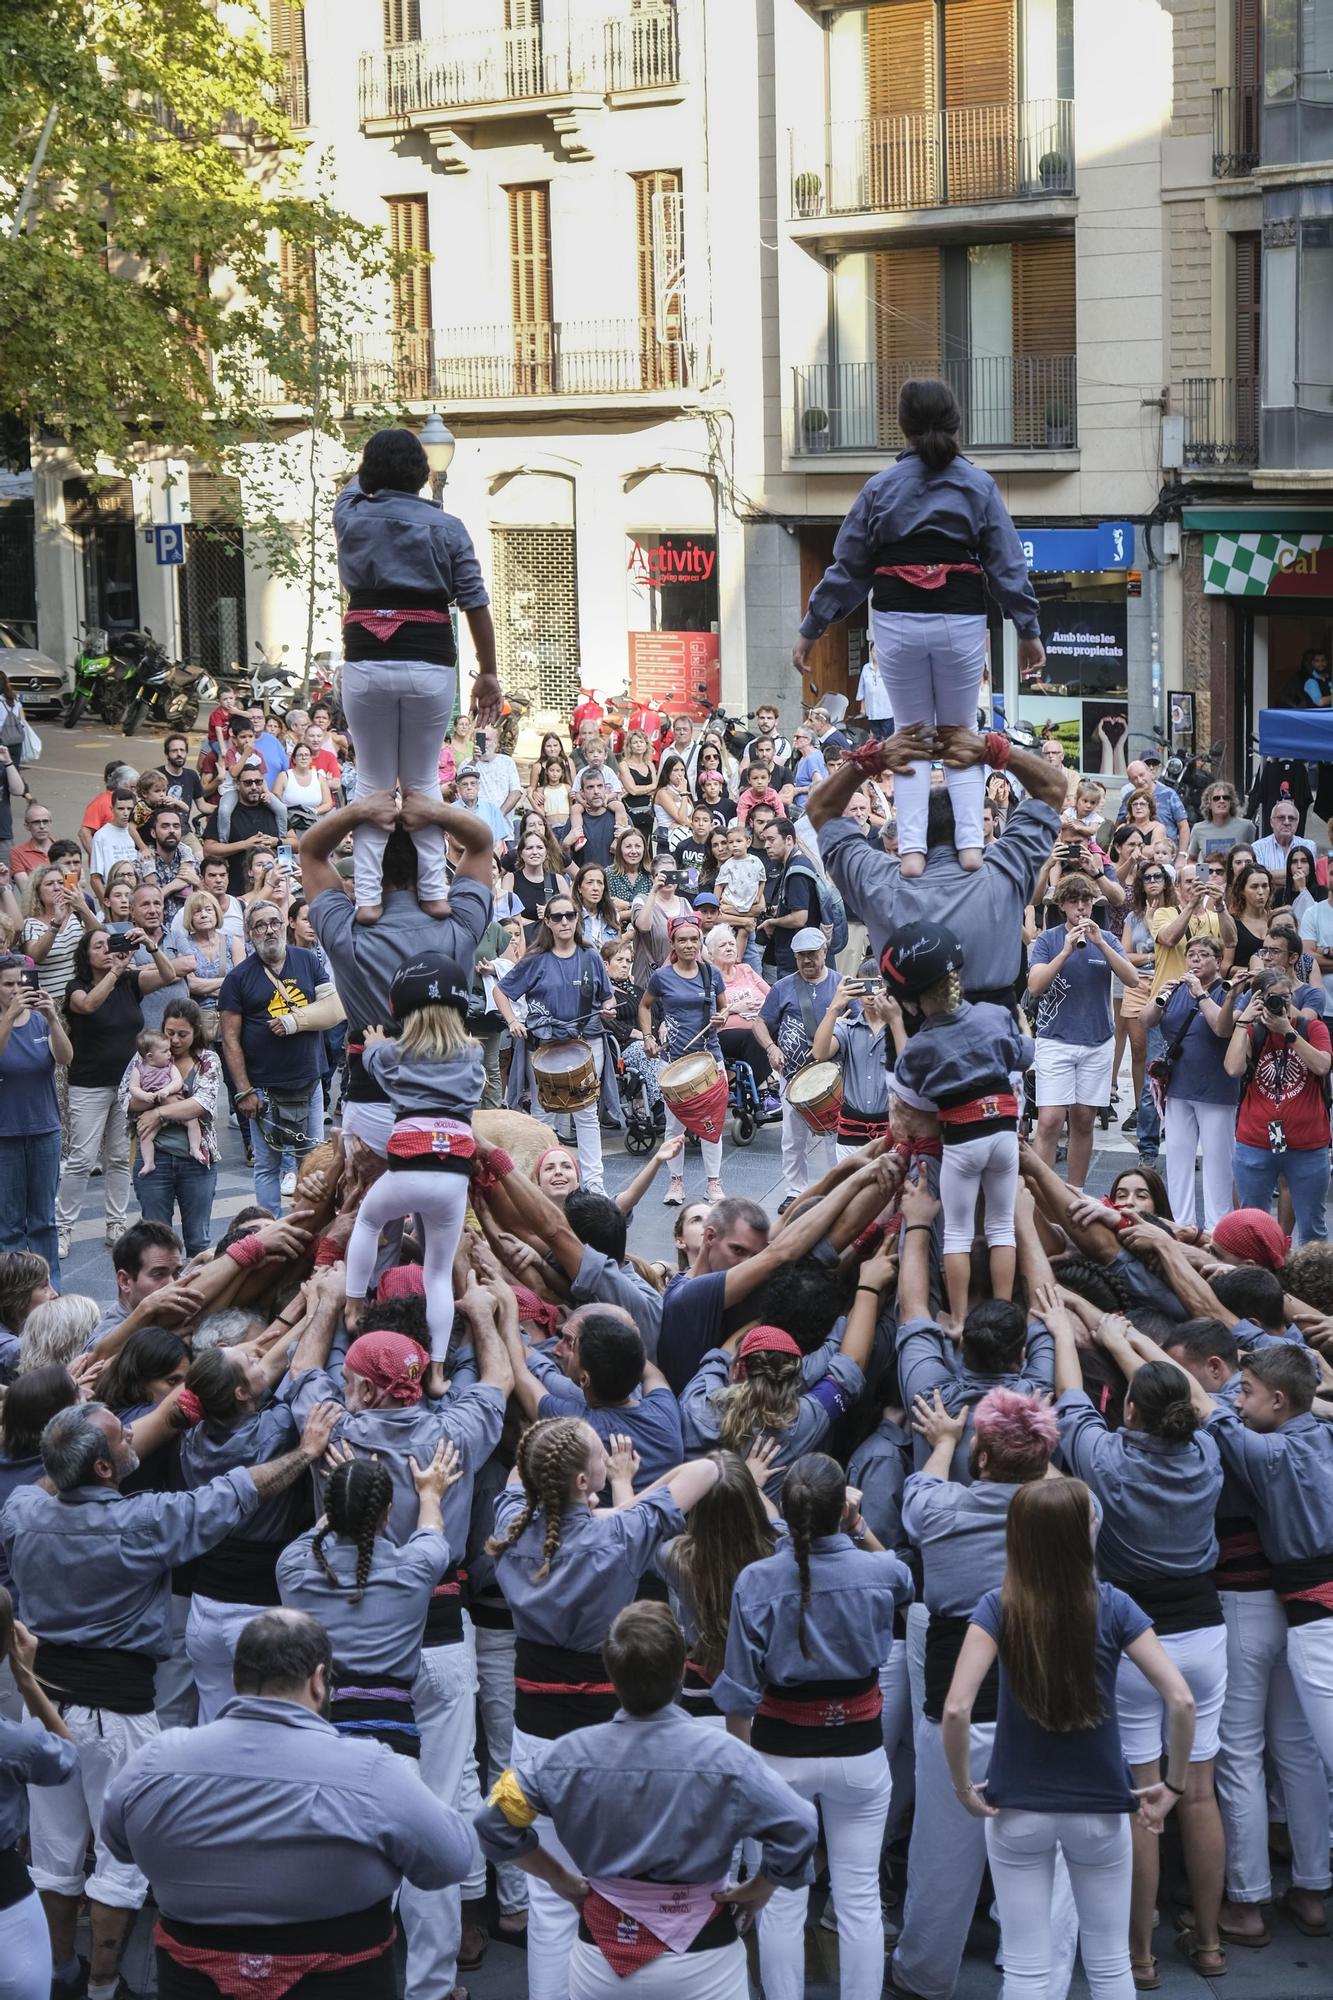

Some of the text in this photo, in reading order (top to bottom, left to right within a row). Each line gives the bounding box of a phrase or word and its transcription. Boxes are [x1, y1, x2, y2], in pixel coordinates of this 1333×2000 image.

[160, 529, 177, 561] P
[628, 541, 716, 579] Activity
[1277, 548, 1318, 574] Cal
[1053, 632, 1115, 644] Amb totes les
[1046, 645, 1123, 657] seves propietats
[683, 850, 704, 862] NAS
